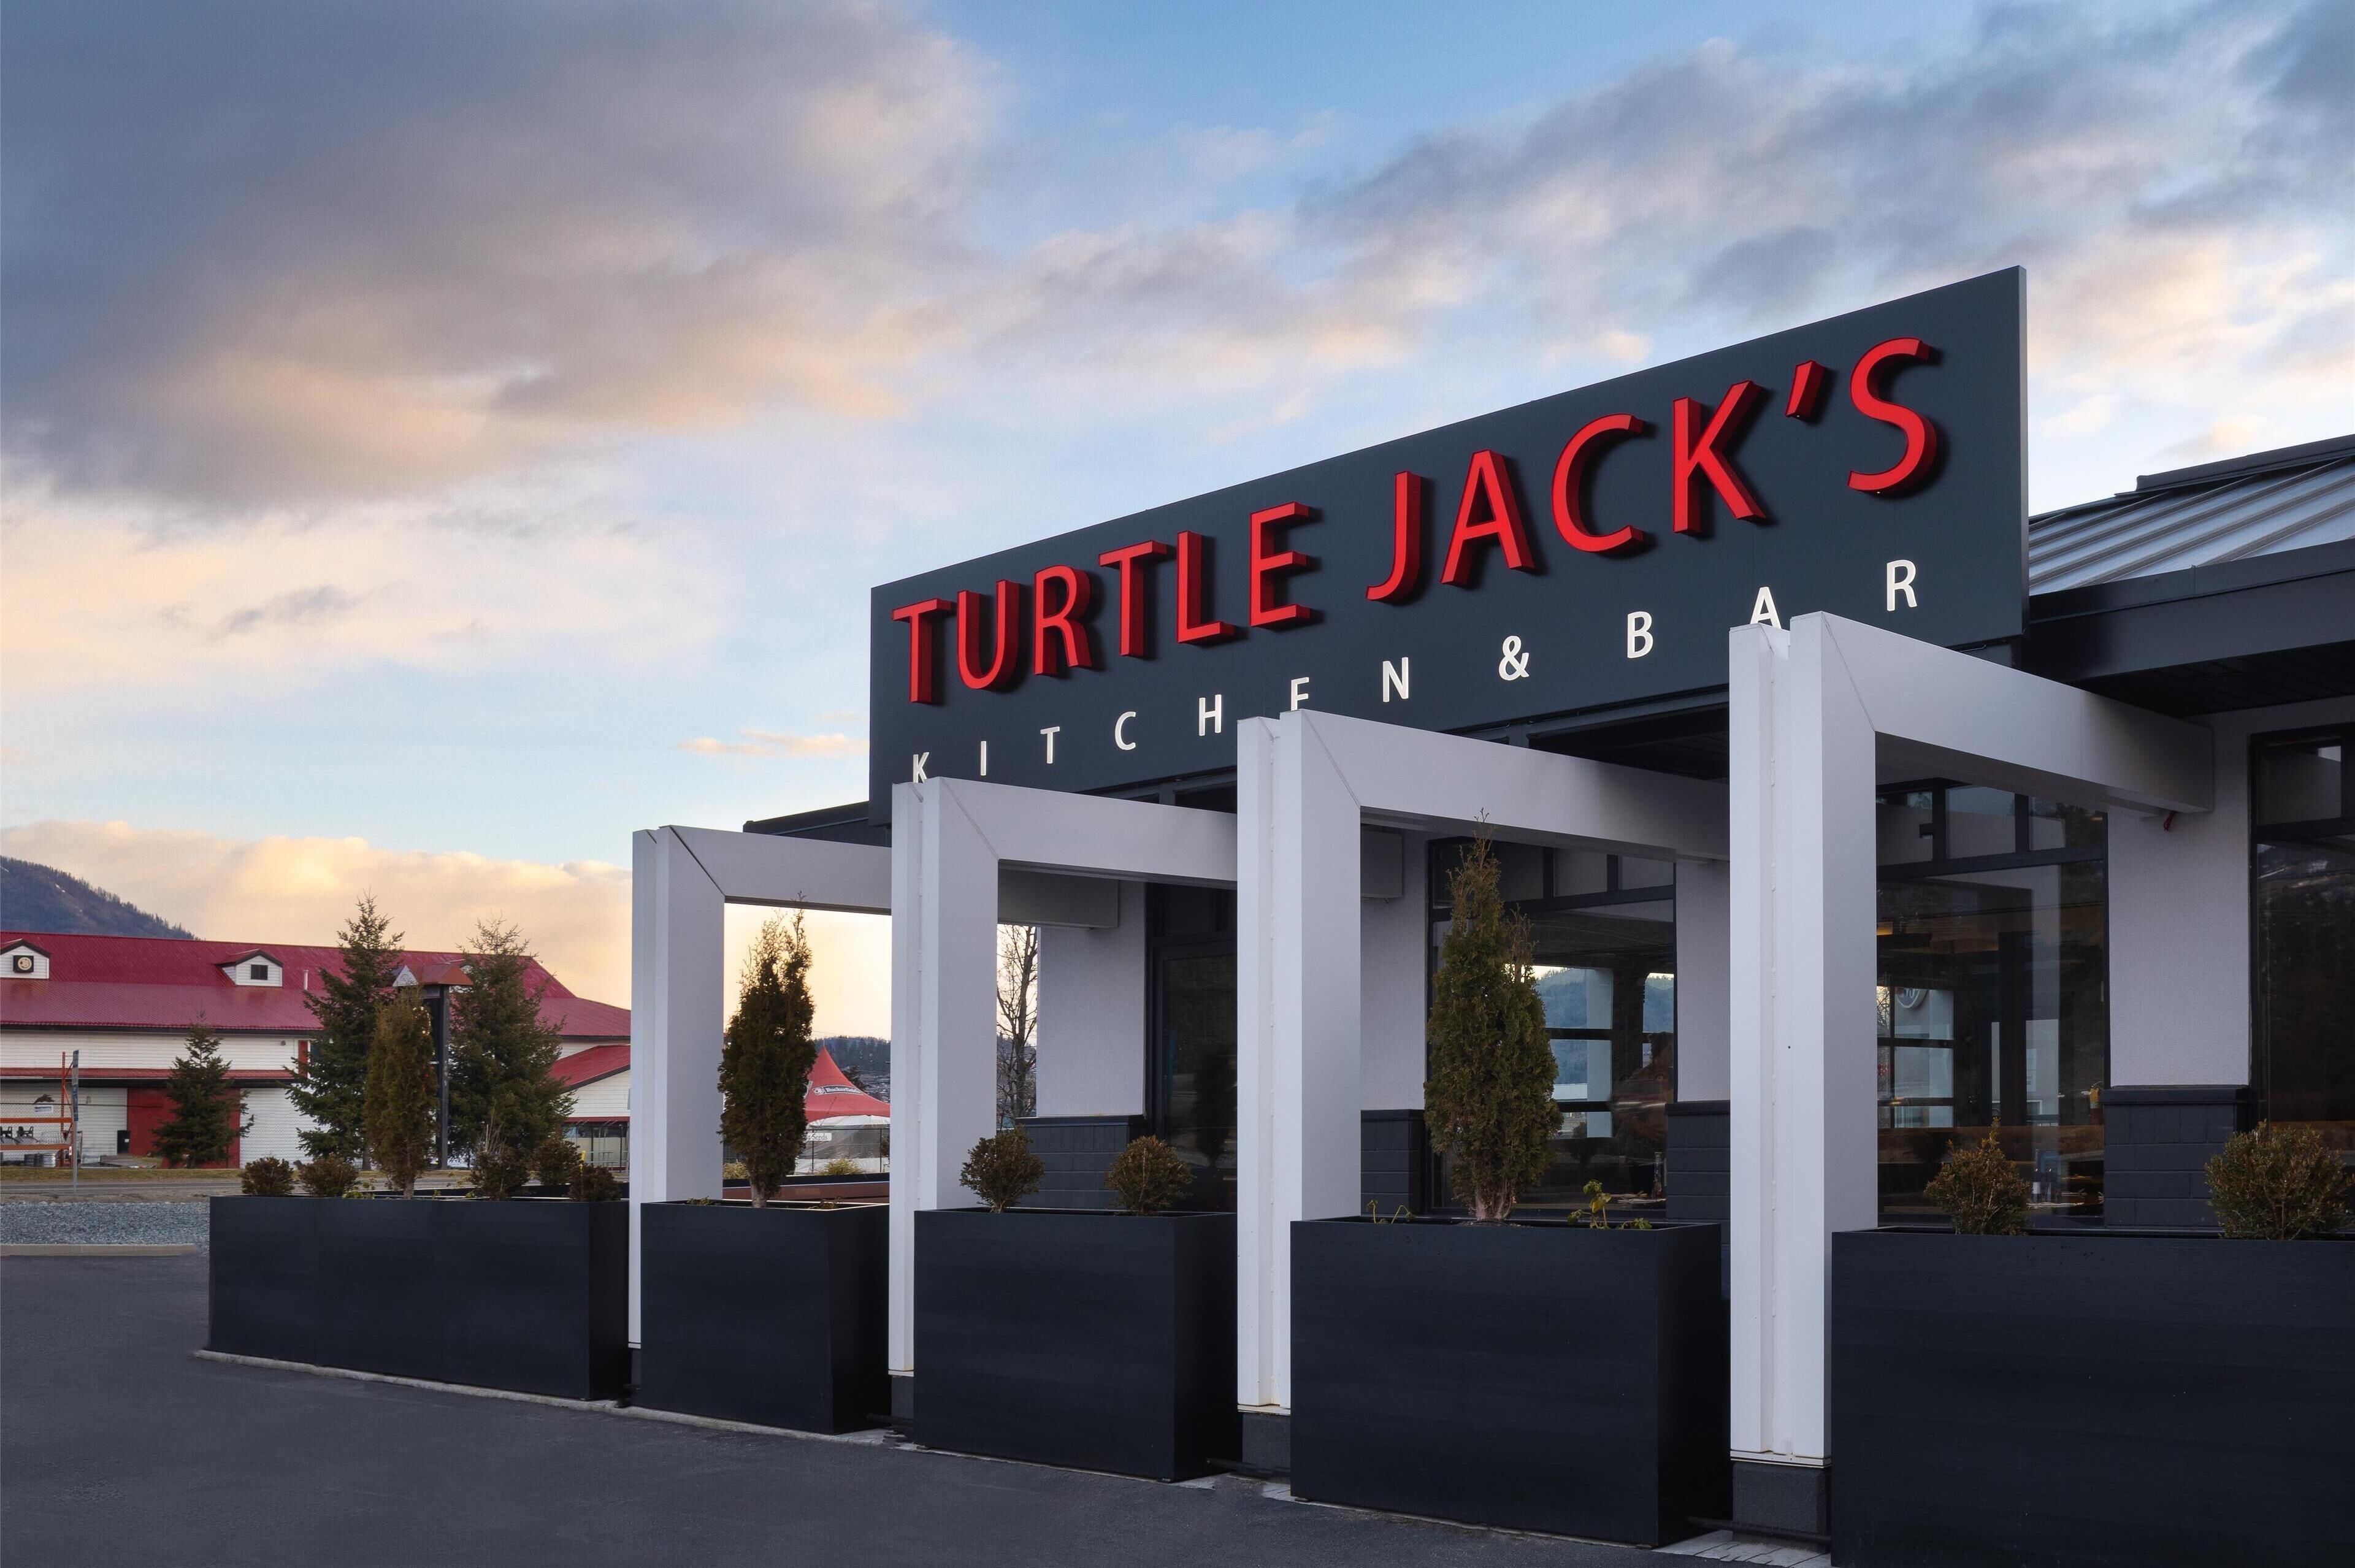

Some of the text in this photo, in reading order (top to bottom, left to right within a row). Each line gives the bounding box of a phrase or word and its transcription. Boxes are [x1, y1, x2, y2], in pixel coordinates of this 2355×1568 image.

[891, 337, 1937, 703] TURTLE JACK'S
[912, 559, 1918, 784] KITCHEN & BAR
